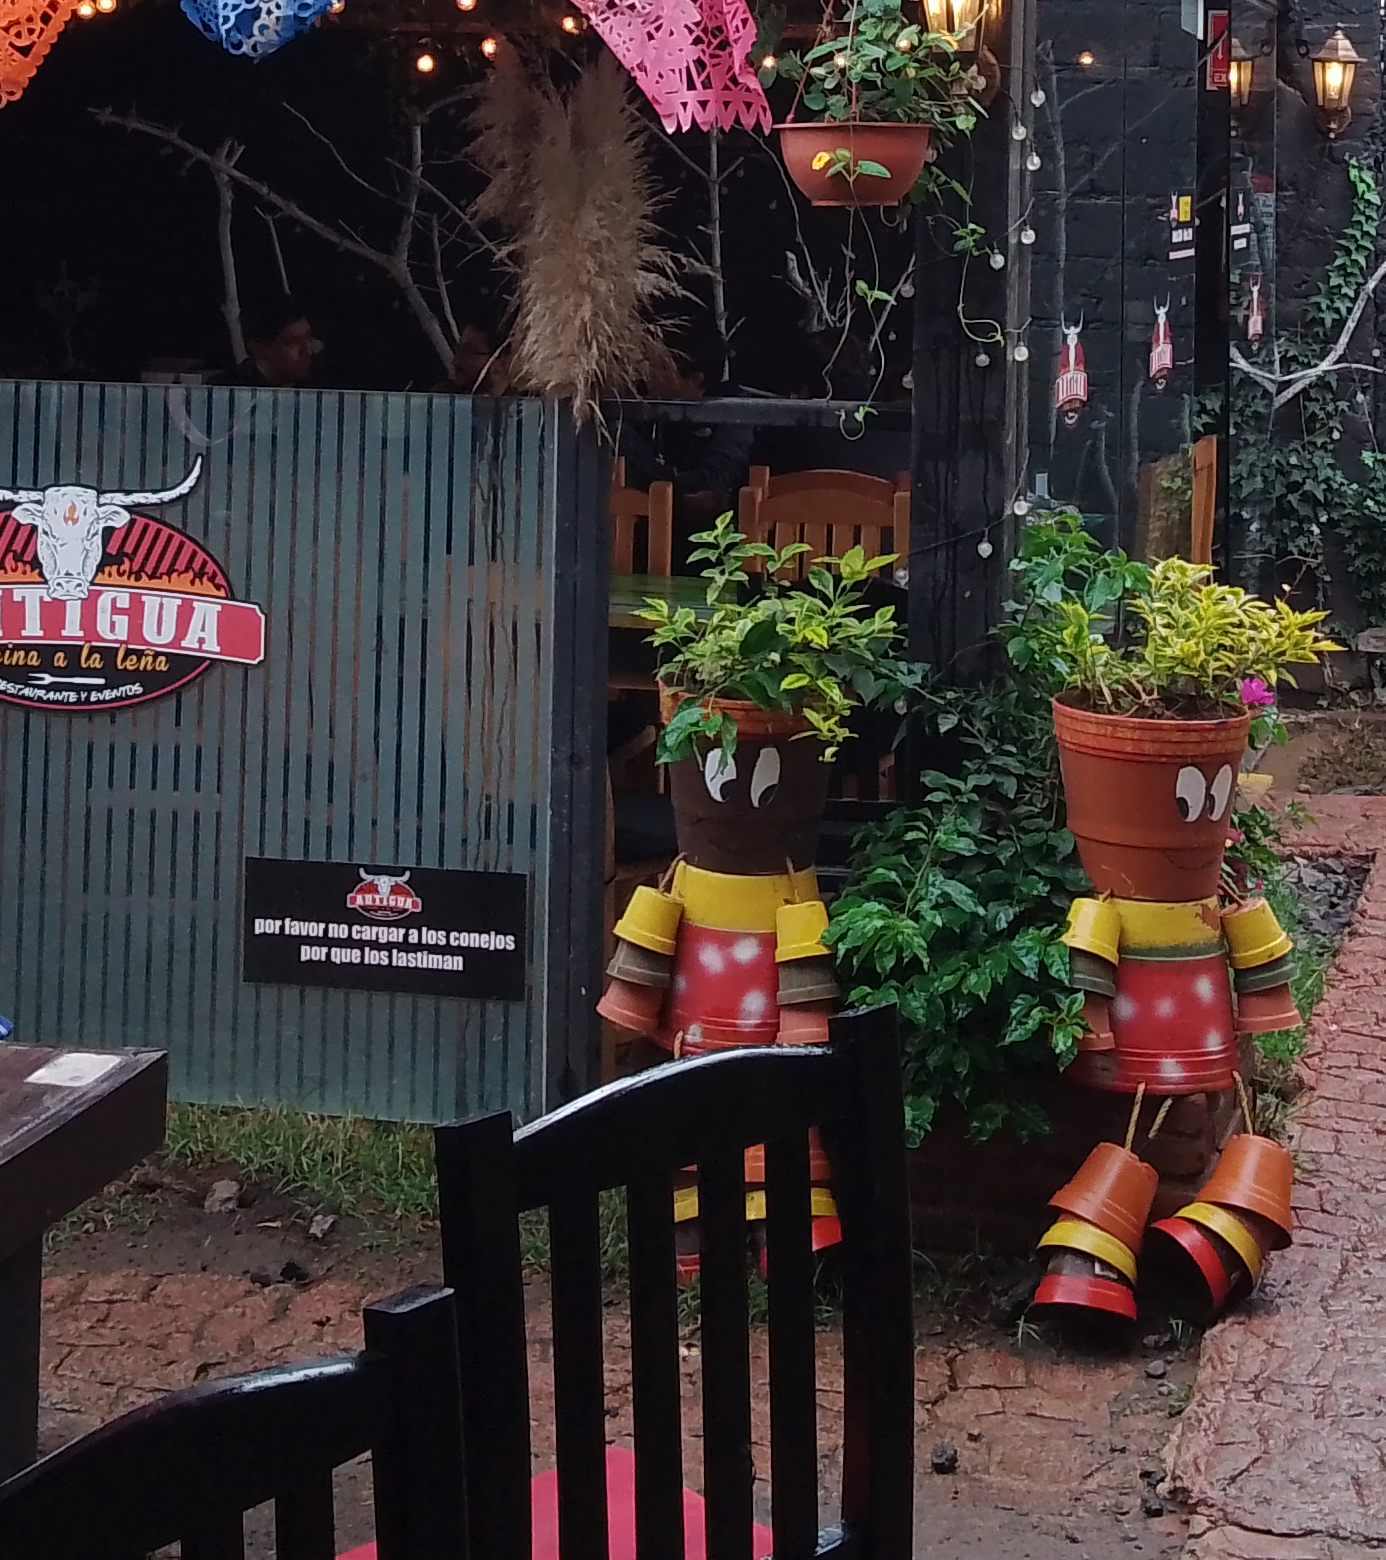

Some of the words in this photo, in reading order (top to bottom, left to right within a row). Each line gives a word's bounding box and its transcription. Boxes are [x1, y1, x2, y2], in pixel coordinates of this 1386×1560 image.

[53, 649, 68, 668] a
[80, 642, 104, 669] la
[116, 643, 170, 672] leña
[90, 683, 144, 702] EVENTOS
[254, 918, 282, 935] por
[284, 918, 325, 938] favor
[328, 924, 348, 939] no
[351, 925, 406, 944] cargar
[408, 929, 419, 944] a
[421, 927, 447, 946] los
[449, 930, 516, 951] conejos
[300, 945, 328, 962] por
[330, 948, 361, 965] que
[364, 947, 390, 966] los
[392, 950, 464, 971] lastiman
